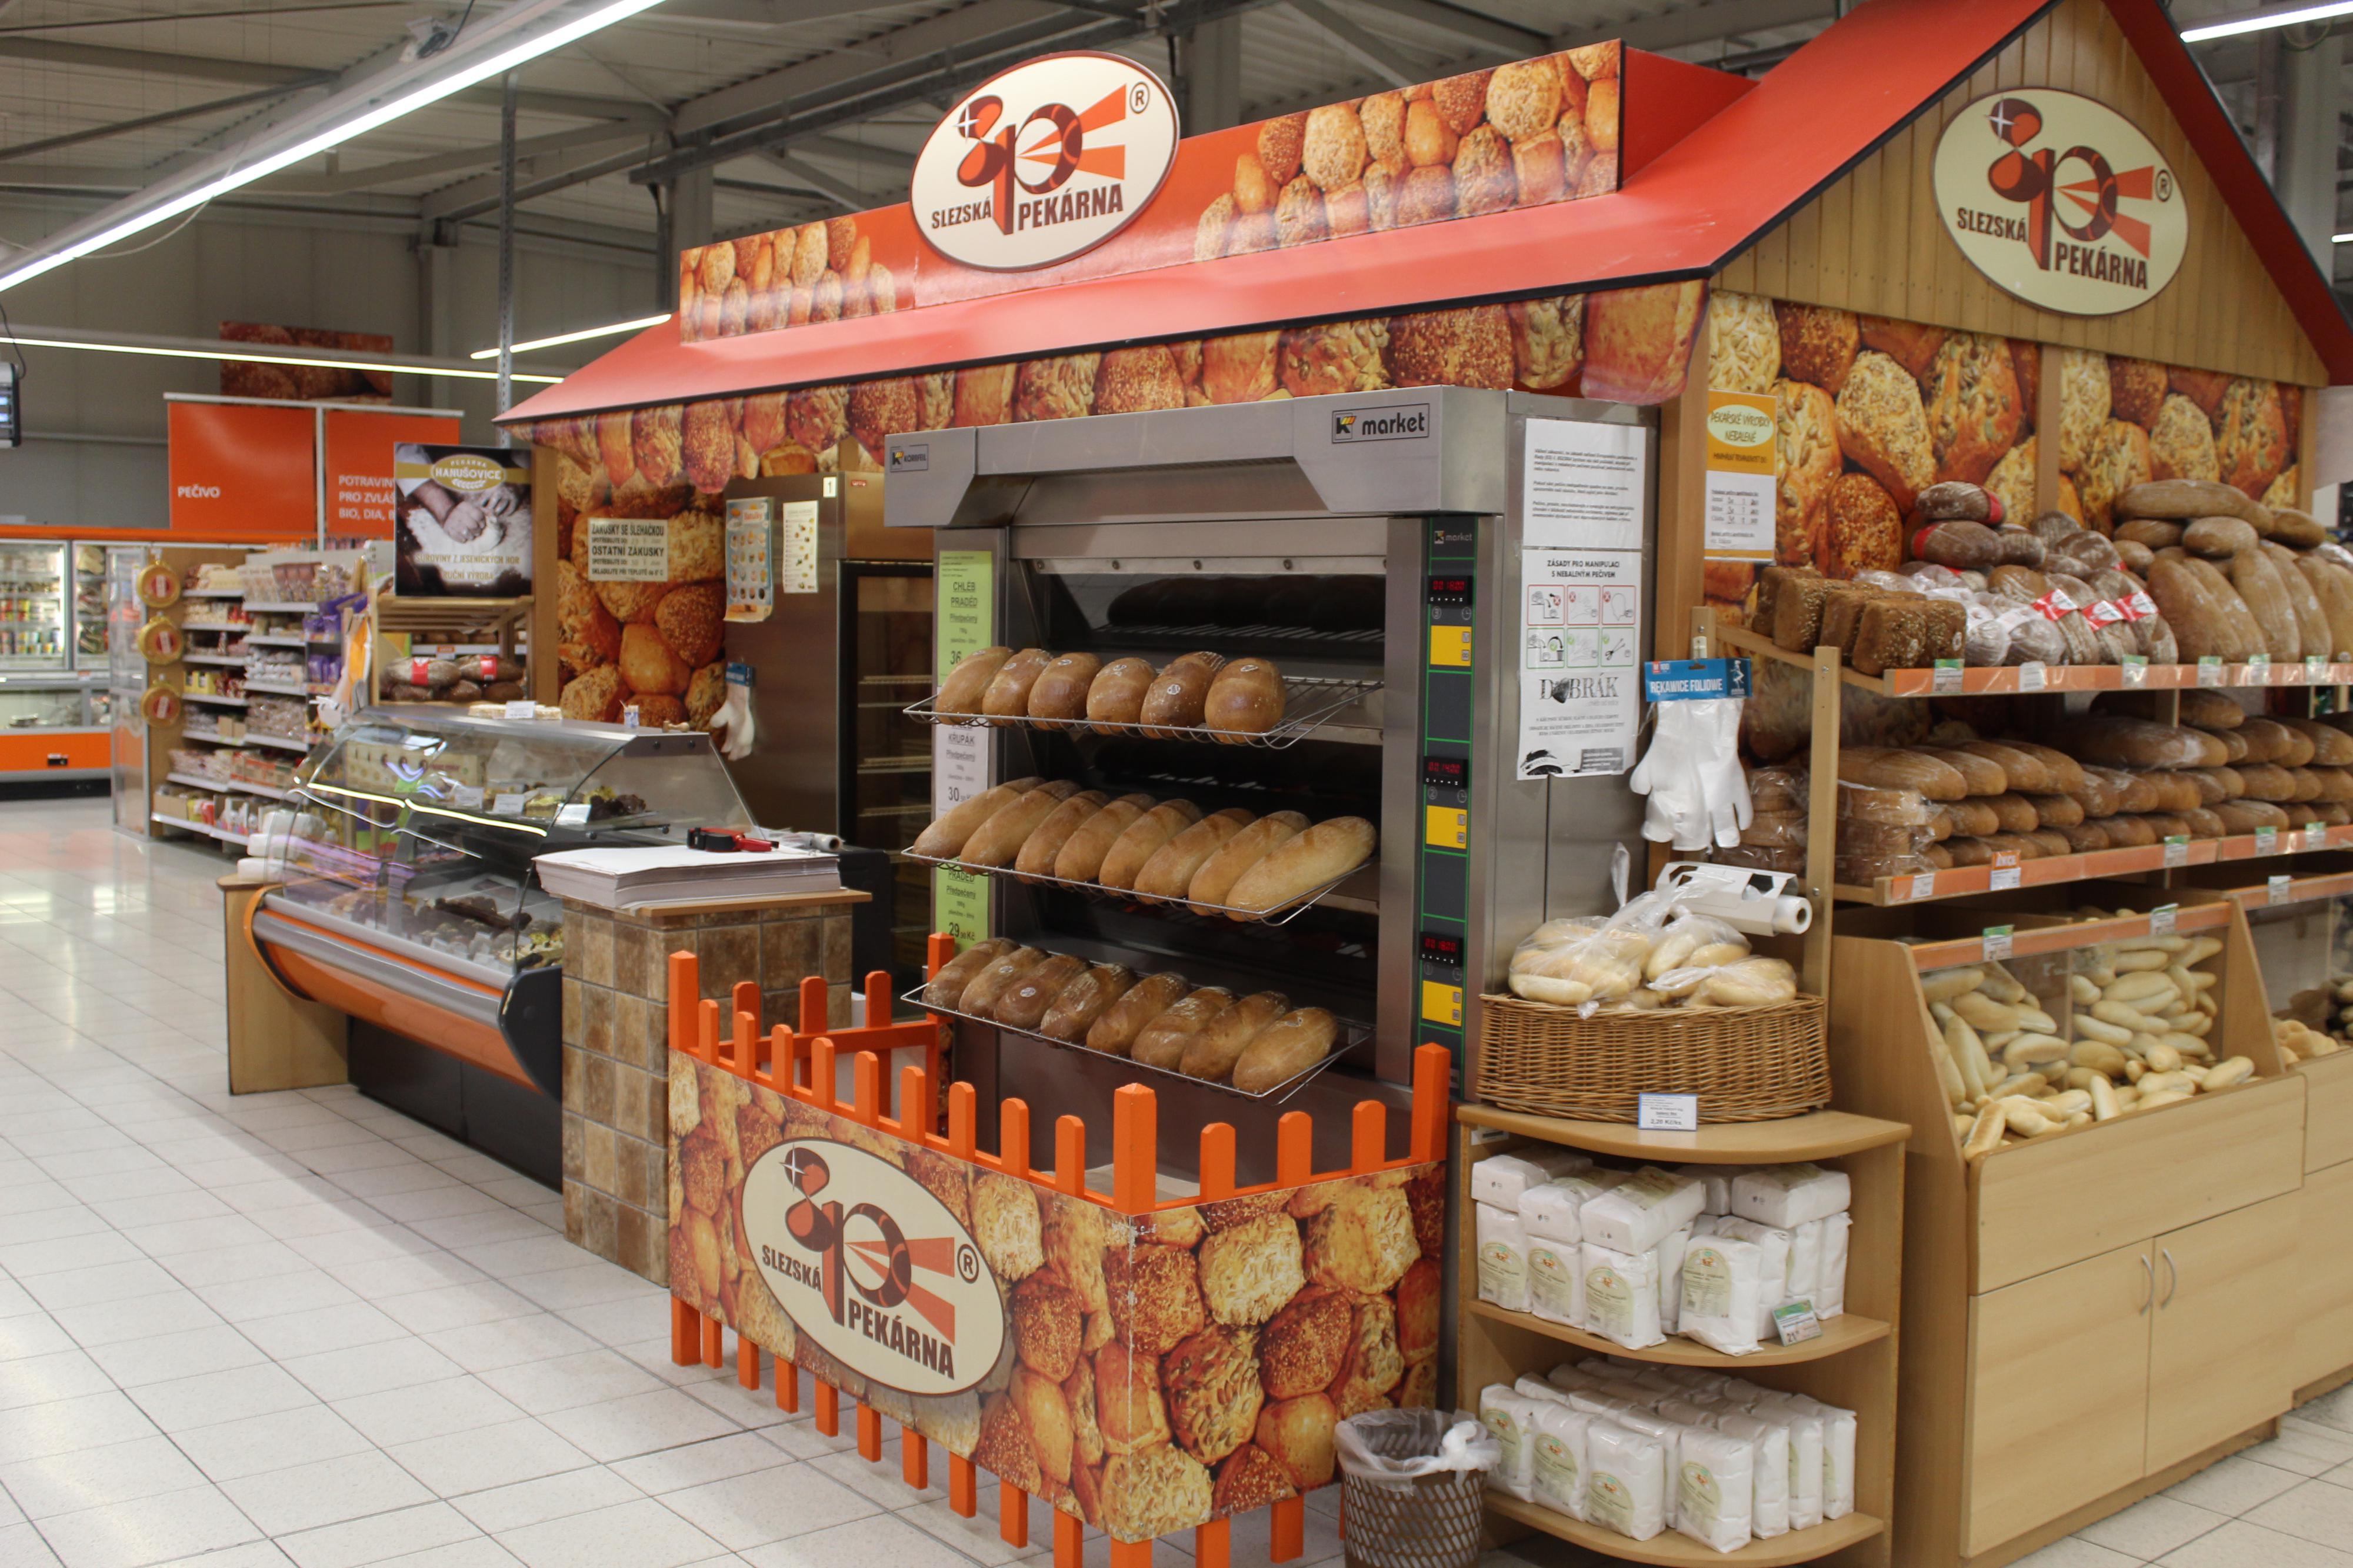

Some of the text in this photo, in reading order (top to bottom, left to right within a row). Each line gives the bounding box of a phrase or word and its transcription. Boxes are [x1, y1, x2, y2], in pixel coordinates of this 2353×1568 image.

[931, 183, 1123, 231] SLEZSKÁ PEKÁRNA
[1957, 208, 2148, 290] SLEZSKÁ PEKÁRNA
[1362, 412, 1425, 435] market
[435, 467, 501, 480] HANUŠOVICE
[178, 484, 221, 498] PEČIVO
[339, 492, 361, 502] PRO
[339, 508, 360, 519] BIO,
[364, 509, 385, 521] DIA,
[1446, 533, 1472, 541] market
[1547, 559, 1571, 568] ZÁSADY
[953, 581, 976, 592] CHLÉB
[951, 650, 962, 665] 36
[1539, 673, 1619, 704] DBRÁK
[1690, 678, 1723, 692] FOLIOWE
[948, 732, 975, 746] KŘUPÁK
[948, 786, 959, 802] 30
[948, 922, 960, 938] 29
[762, 1245, 954, 1380] SLEZSKÁ PEKÁRNA
